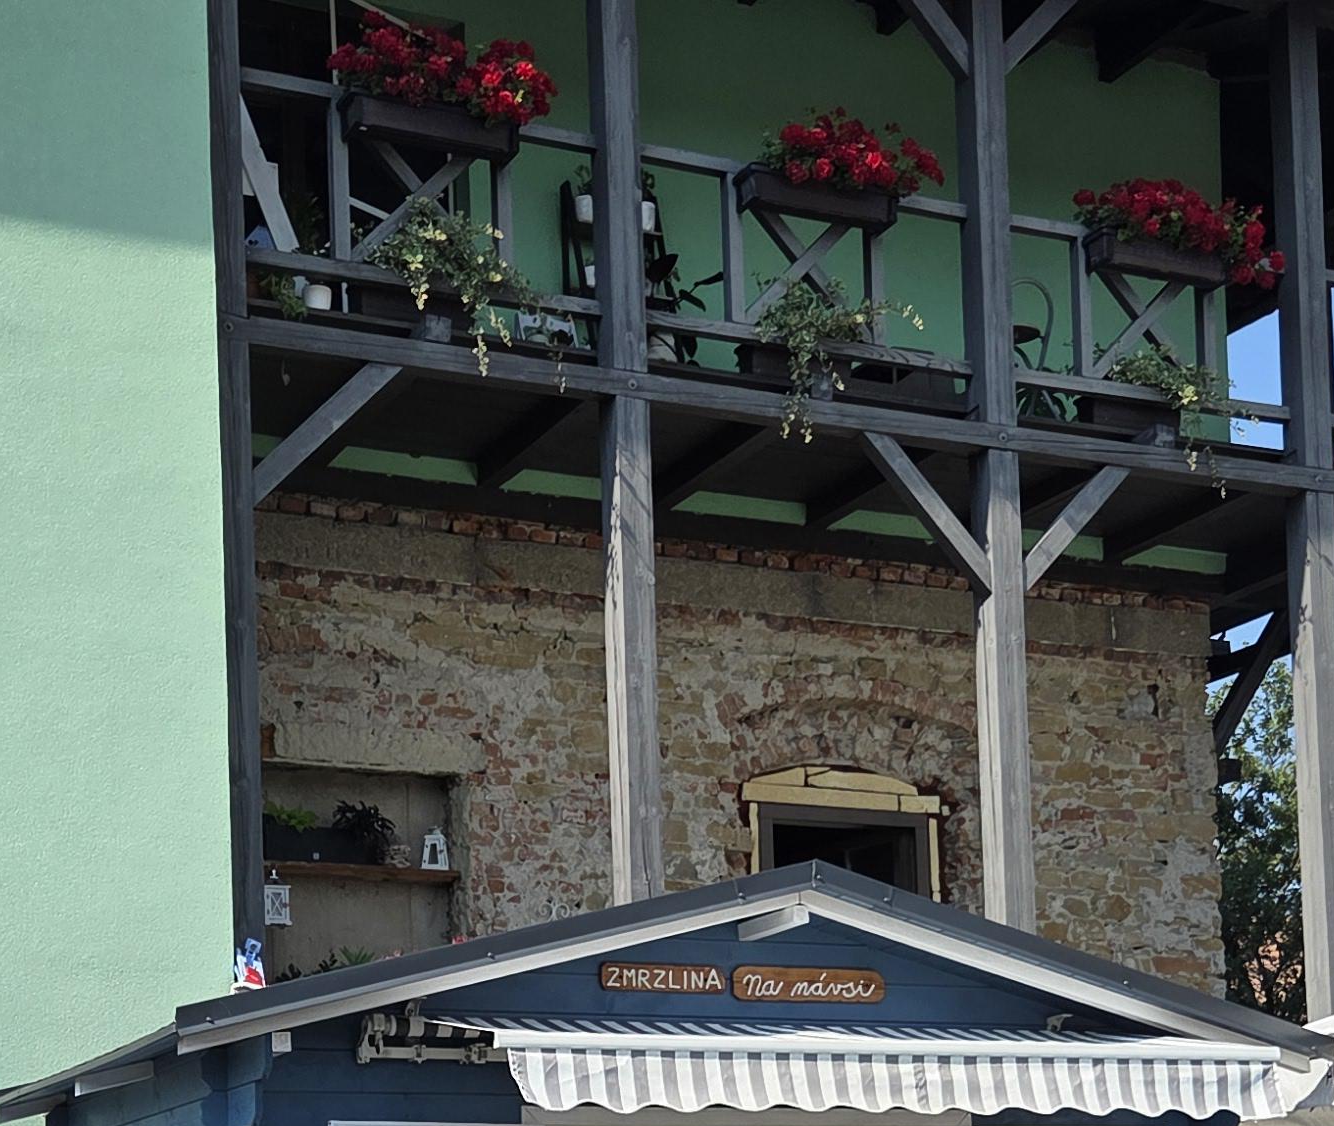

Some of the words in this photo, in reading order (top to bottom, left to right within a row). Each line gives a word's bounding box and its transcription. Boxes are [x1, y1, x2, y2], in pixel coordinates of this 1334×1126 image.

[606, 967, 722, 990] ZMRZLINA
[743, 973, 784, 997] Na
[790, 972, 876, 998] návsi
